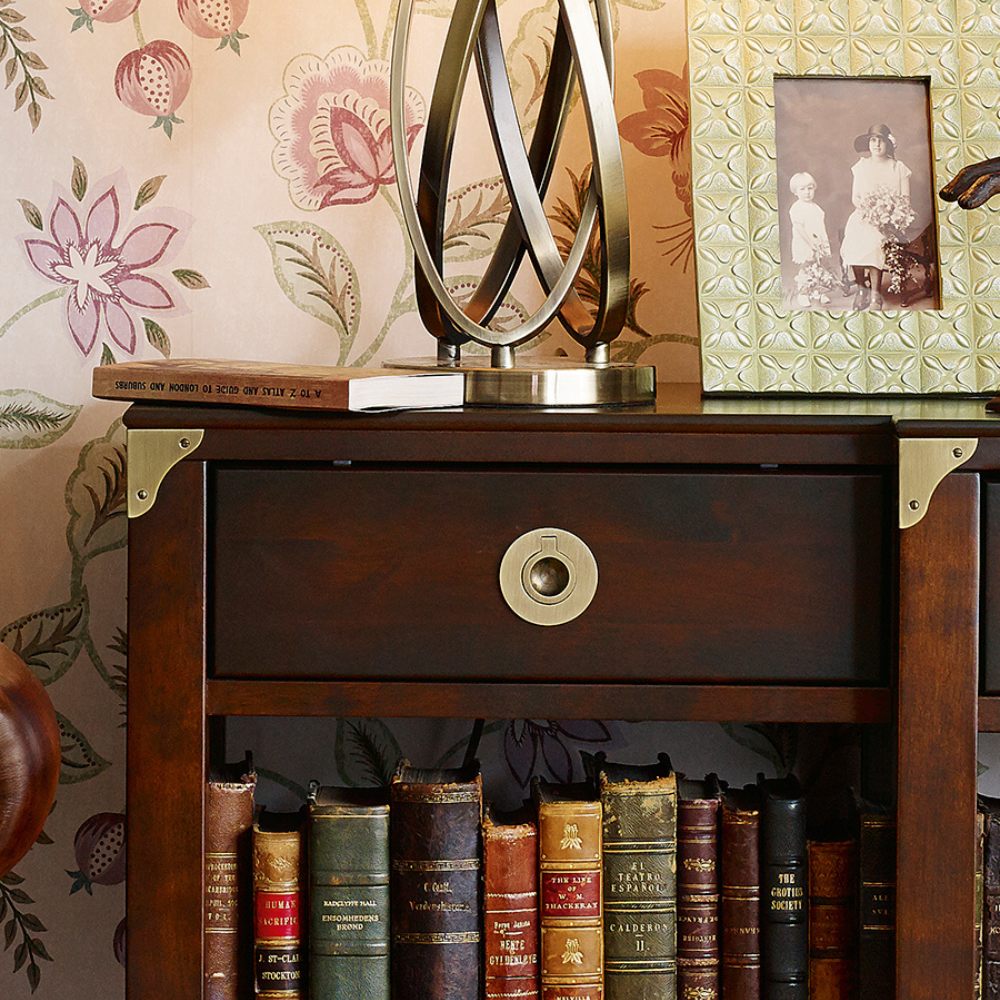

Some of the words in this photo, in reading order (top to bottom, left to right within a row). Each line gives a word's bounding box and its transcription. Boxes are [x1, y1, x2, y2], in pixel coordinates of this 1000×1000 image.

[115, 380, 146, 390] SUBURBS
[150, 382, 165, 391] AND
[169, 383, 198, 392] LONDON
[202, 384, 212, 394] TO
[216, 385, 239, 395] GUIDE
[243, 386, 258, 395] AND
[262, 387, 285, 397] ATLAS
[289, 388, 297, 397] Z
[301, 389, 310, 398] TO
[314, 389, 322, 398] A
[630, 861, 644, 871] EL
[551, 876, 570, 884] THE
[572, 876, 592, 884] LIFE
[618, 872, 661, 882] TEATRO
[778, 873, 796, 884] THE
[770, 887, 803, 898] GROTIUS
[545, 901, 599, 910] THACKERAY
[770, 900, 802, 910] SOCIETY
